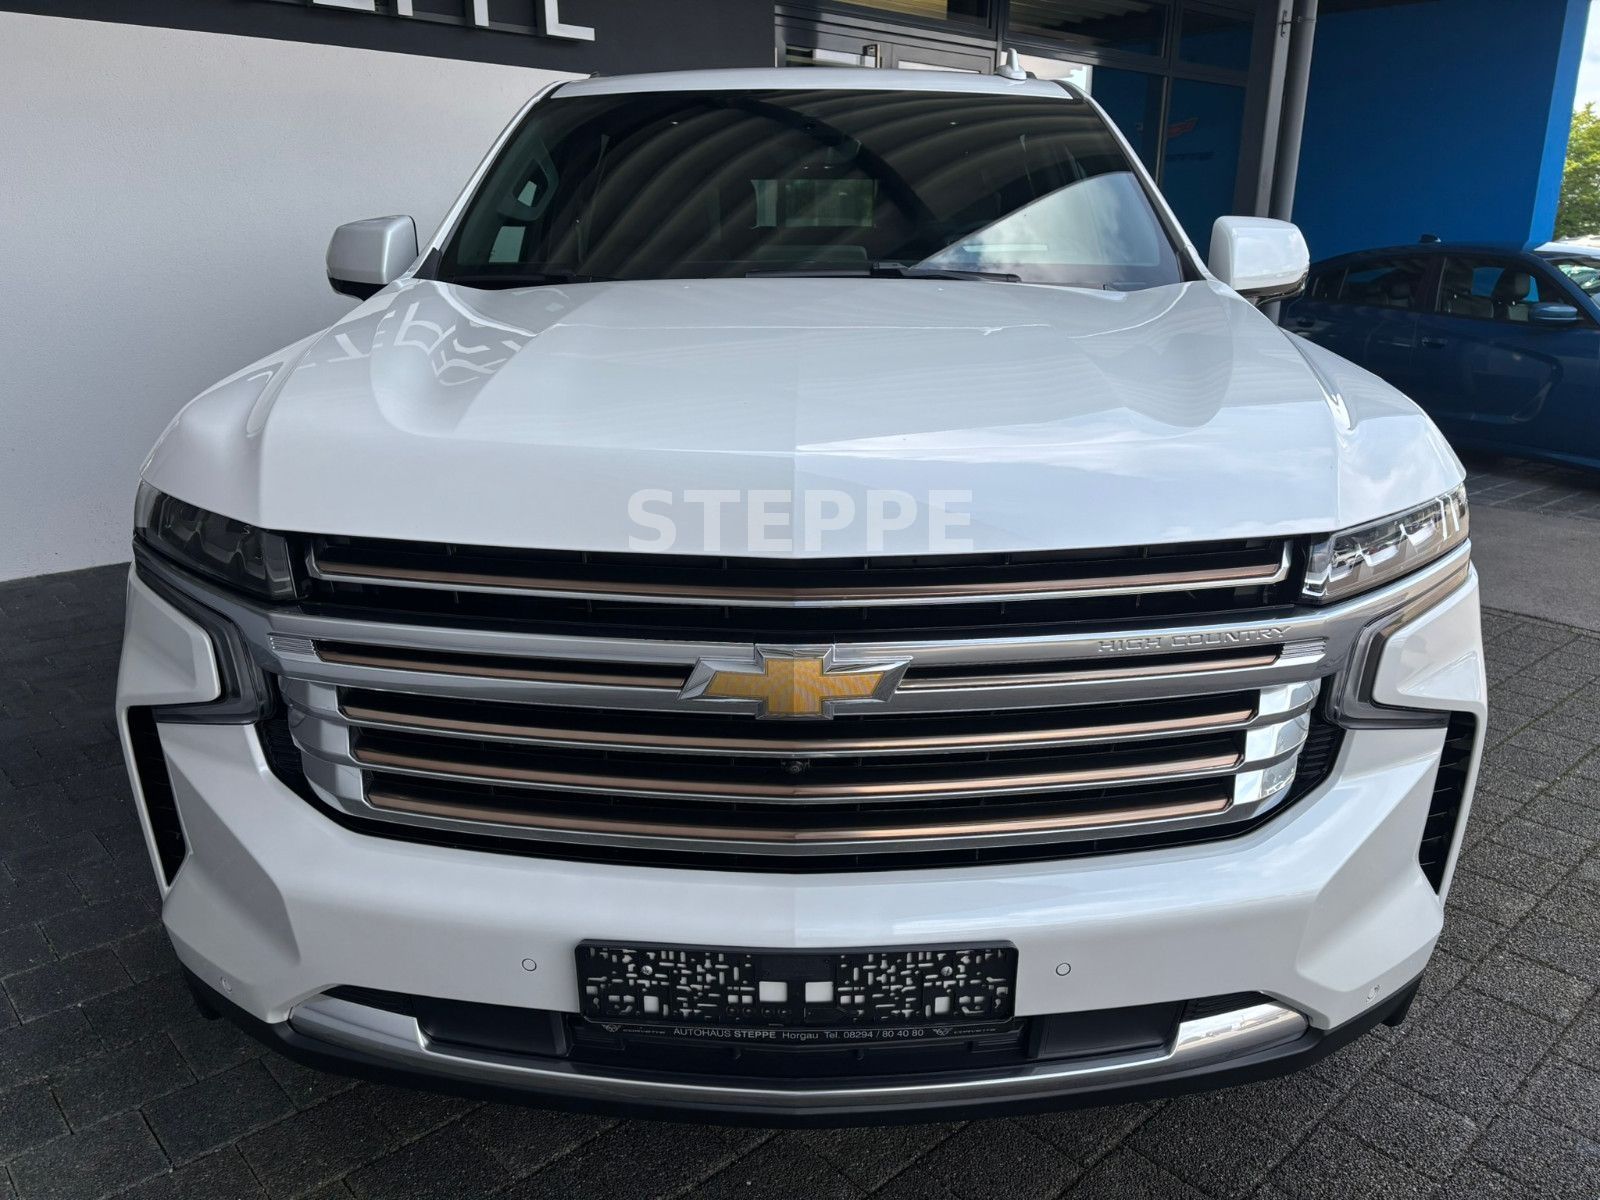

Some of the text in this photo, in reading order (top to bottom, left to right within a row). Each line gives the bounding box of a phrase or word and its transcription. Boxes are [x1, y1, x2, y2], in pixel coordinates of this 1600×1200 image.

[1098, 626, 1292, 652] HIGH COUNTRY
[673, 1027, 732, 1038] AUTOHAUS
[734, 1030, 777, 1039] STEPPE
[782, 1031, 819, 1040] Horgau
[824, 1031, 840, 1039] Tel.
[843, 1030, 873, 1039] 08294
[882, 1029, 894, 1037] 80
[897, 1029, 908, 1037] 40
[911, 1029, 924, 1037] 80
